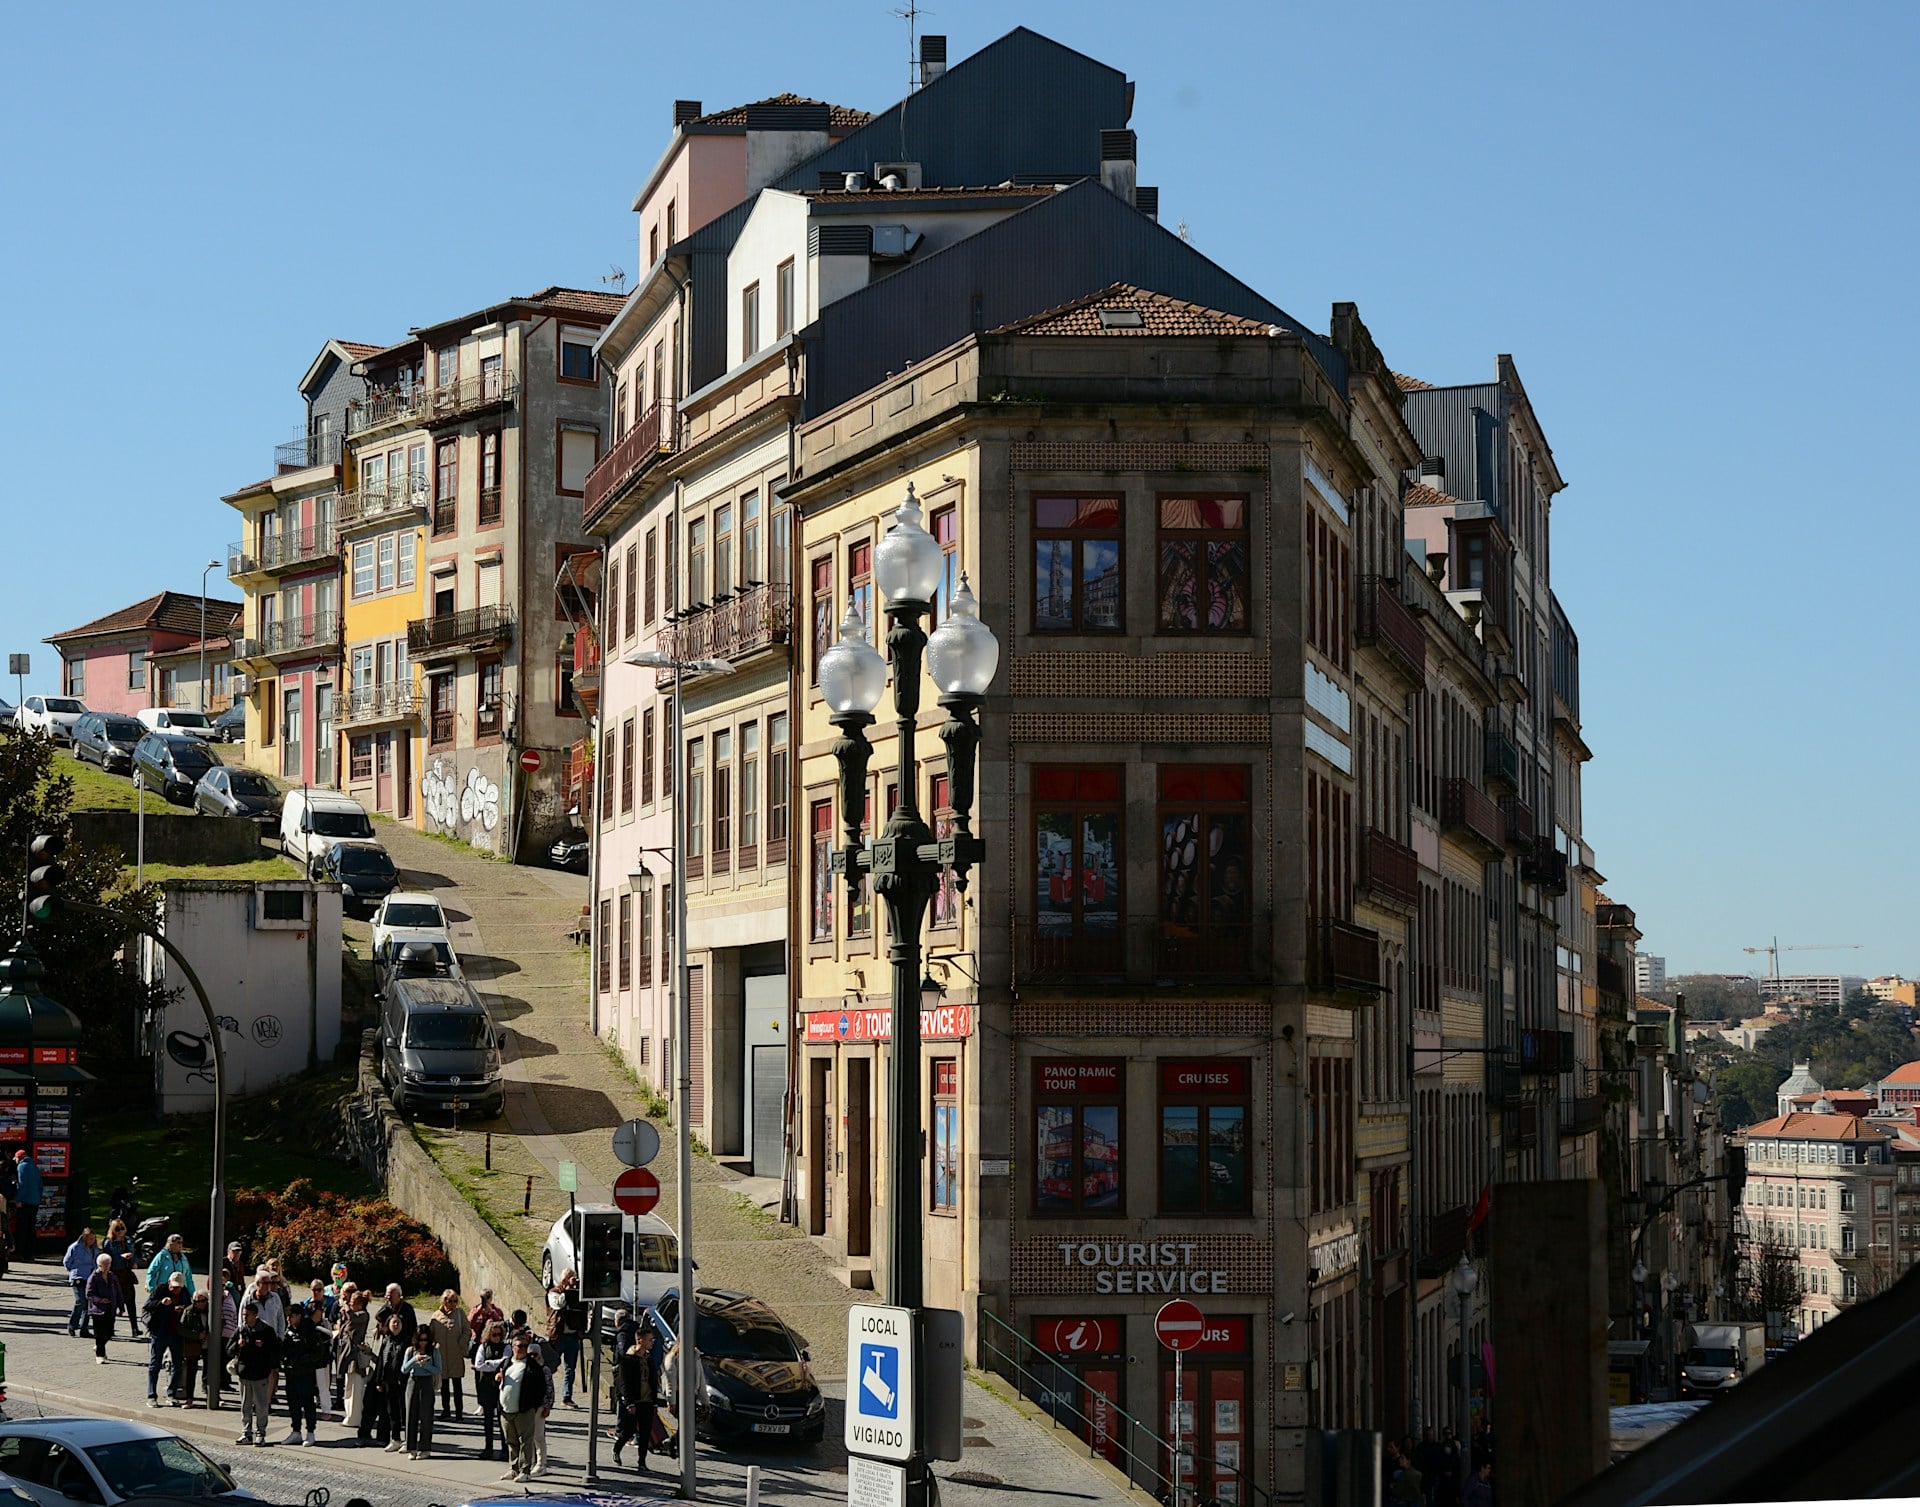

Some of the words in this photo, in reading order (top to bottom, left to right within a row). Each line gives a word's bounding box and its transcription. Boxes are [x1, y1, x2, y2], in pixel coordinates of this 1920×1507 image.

[866, 1012, 892, 1037] TOUR
[1044, 1079, 1076, 1090] TOUR
[1058, 1243, 1196, 1266] TOURIST
[1096, 1271, 1228, 1294] SERVICE
[861, 1317, 898, 1336] LOCAL
[1202, 1329, 1230, 1342] URS
[853, 1425, 903, 1448] VIGIADO
